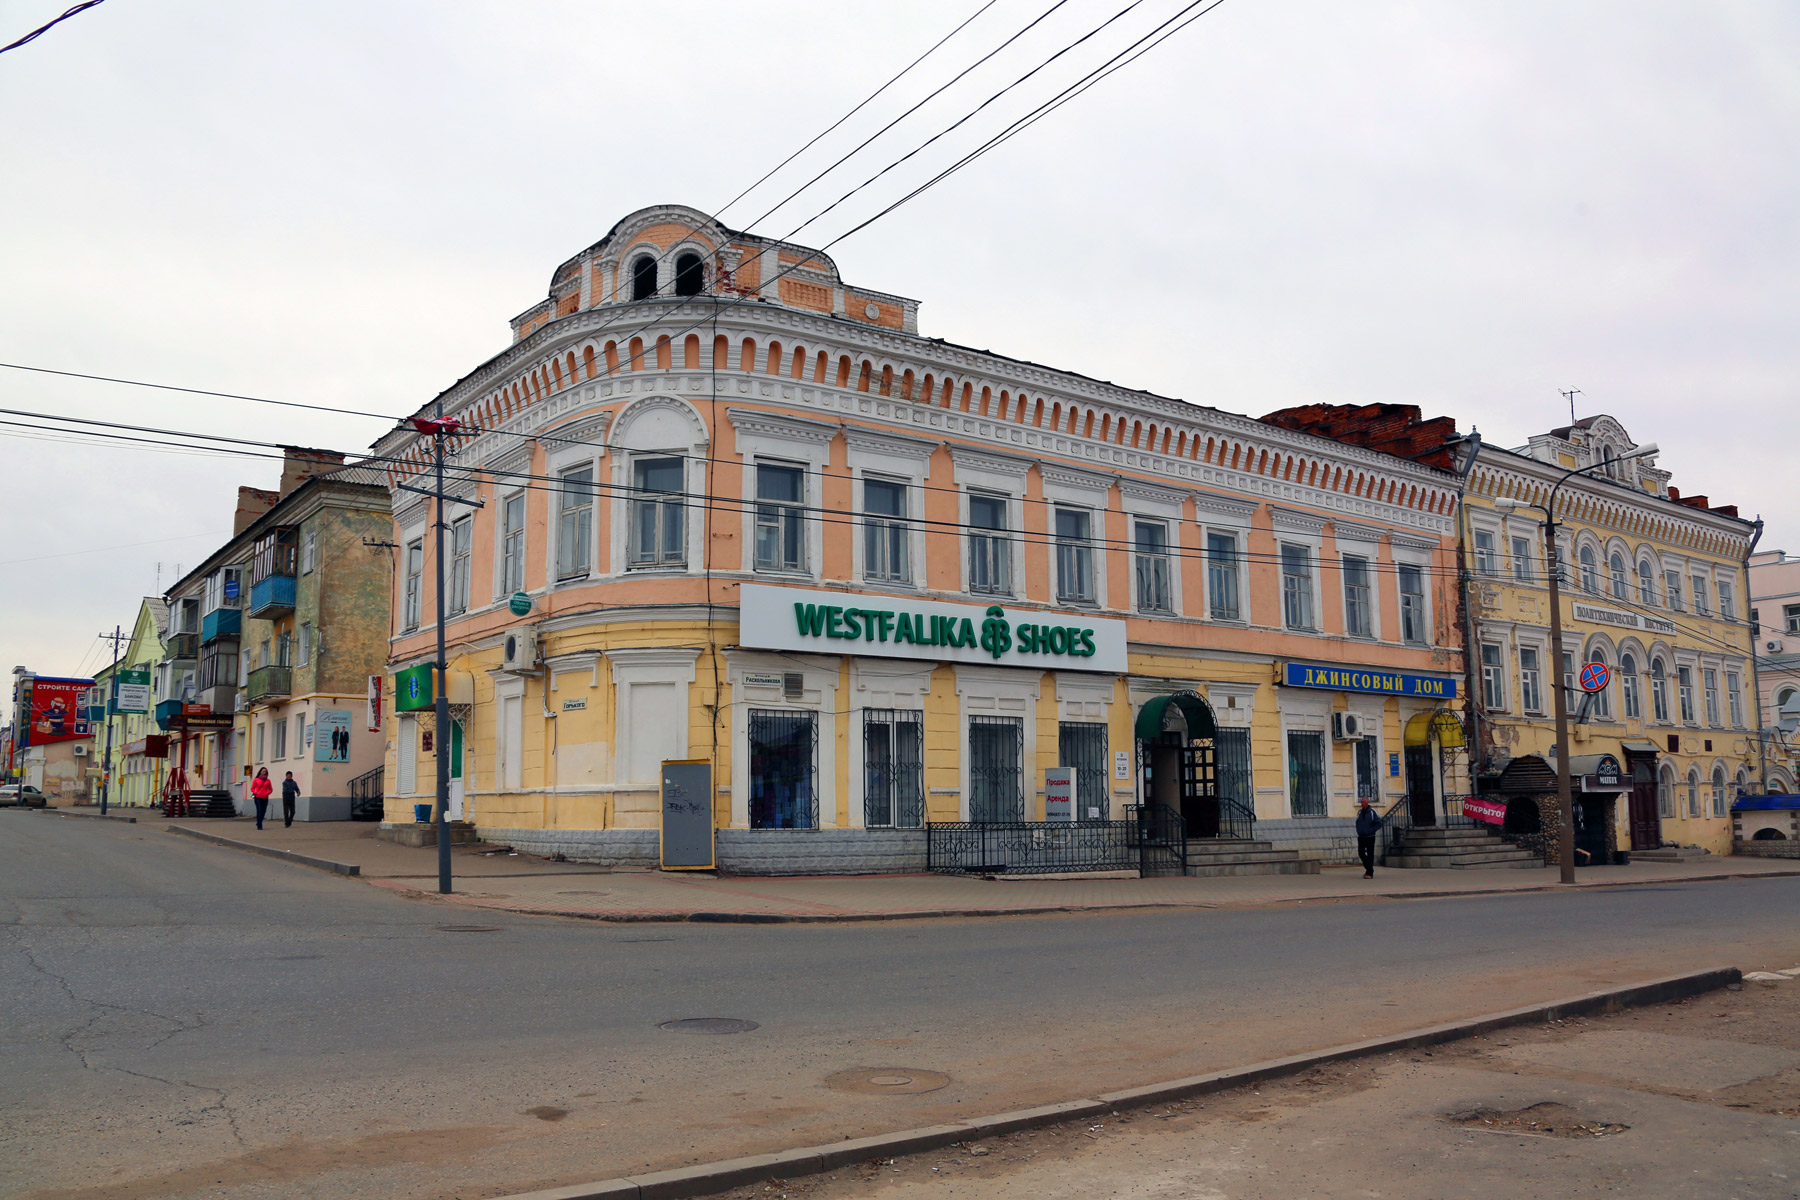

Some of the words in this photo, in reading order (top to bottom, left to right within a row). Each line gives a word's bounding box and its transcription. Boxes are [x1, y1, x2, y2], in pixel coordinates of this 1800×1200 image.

[794, 602, 978, 649] WESTFALIKA
[1017, 623, 1095, 657] SHOES
[37, 683, 70, 691] СТРОЙТЕ
[1304, 668, 1403, 691] ДЖИНСОВЫЙ
[1414, 679, 1443, 694] ДОМ
[1599, 764, 1618, 774] MGM
[1047, 795, 1069, 803] Аренда
[1464, 803, 1505, 819] ОТКРЫТО!
